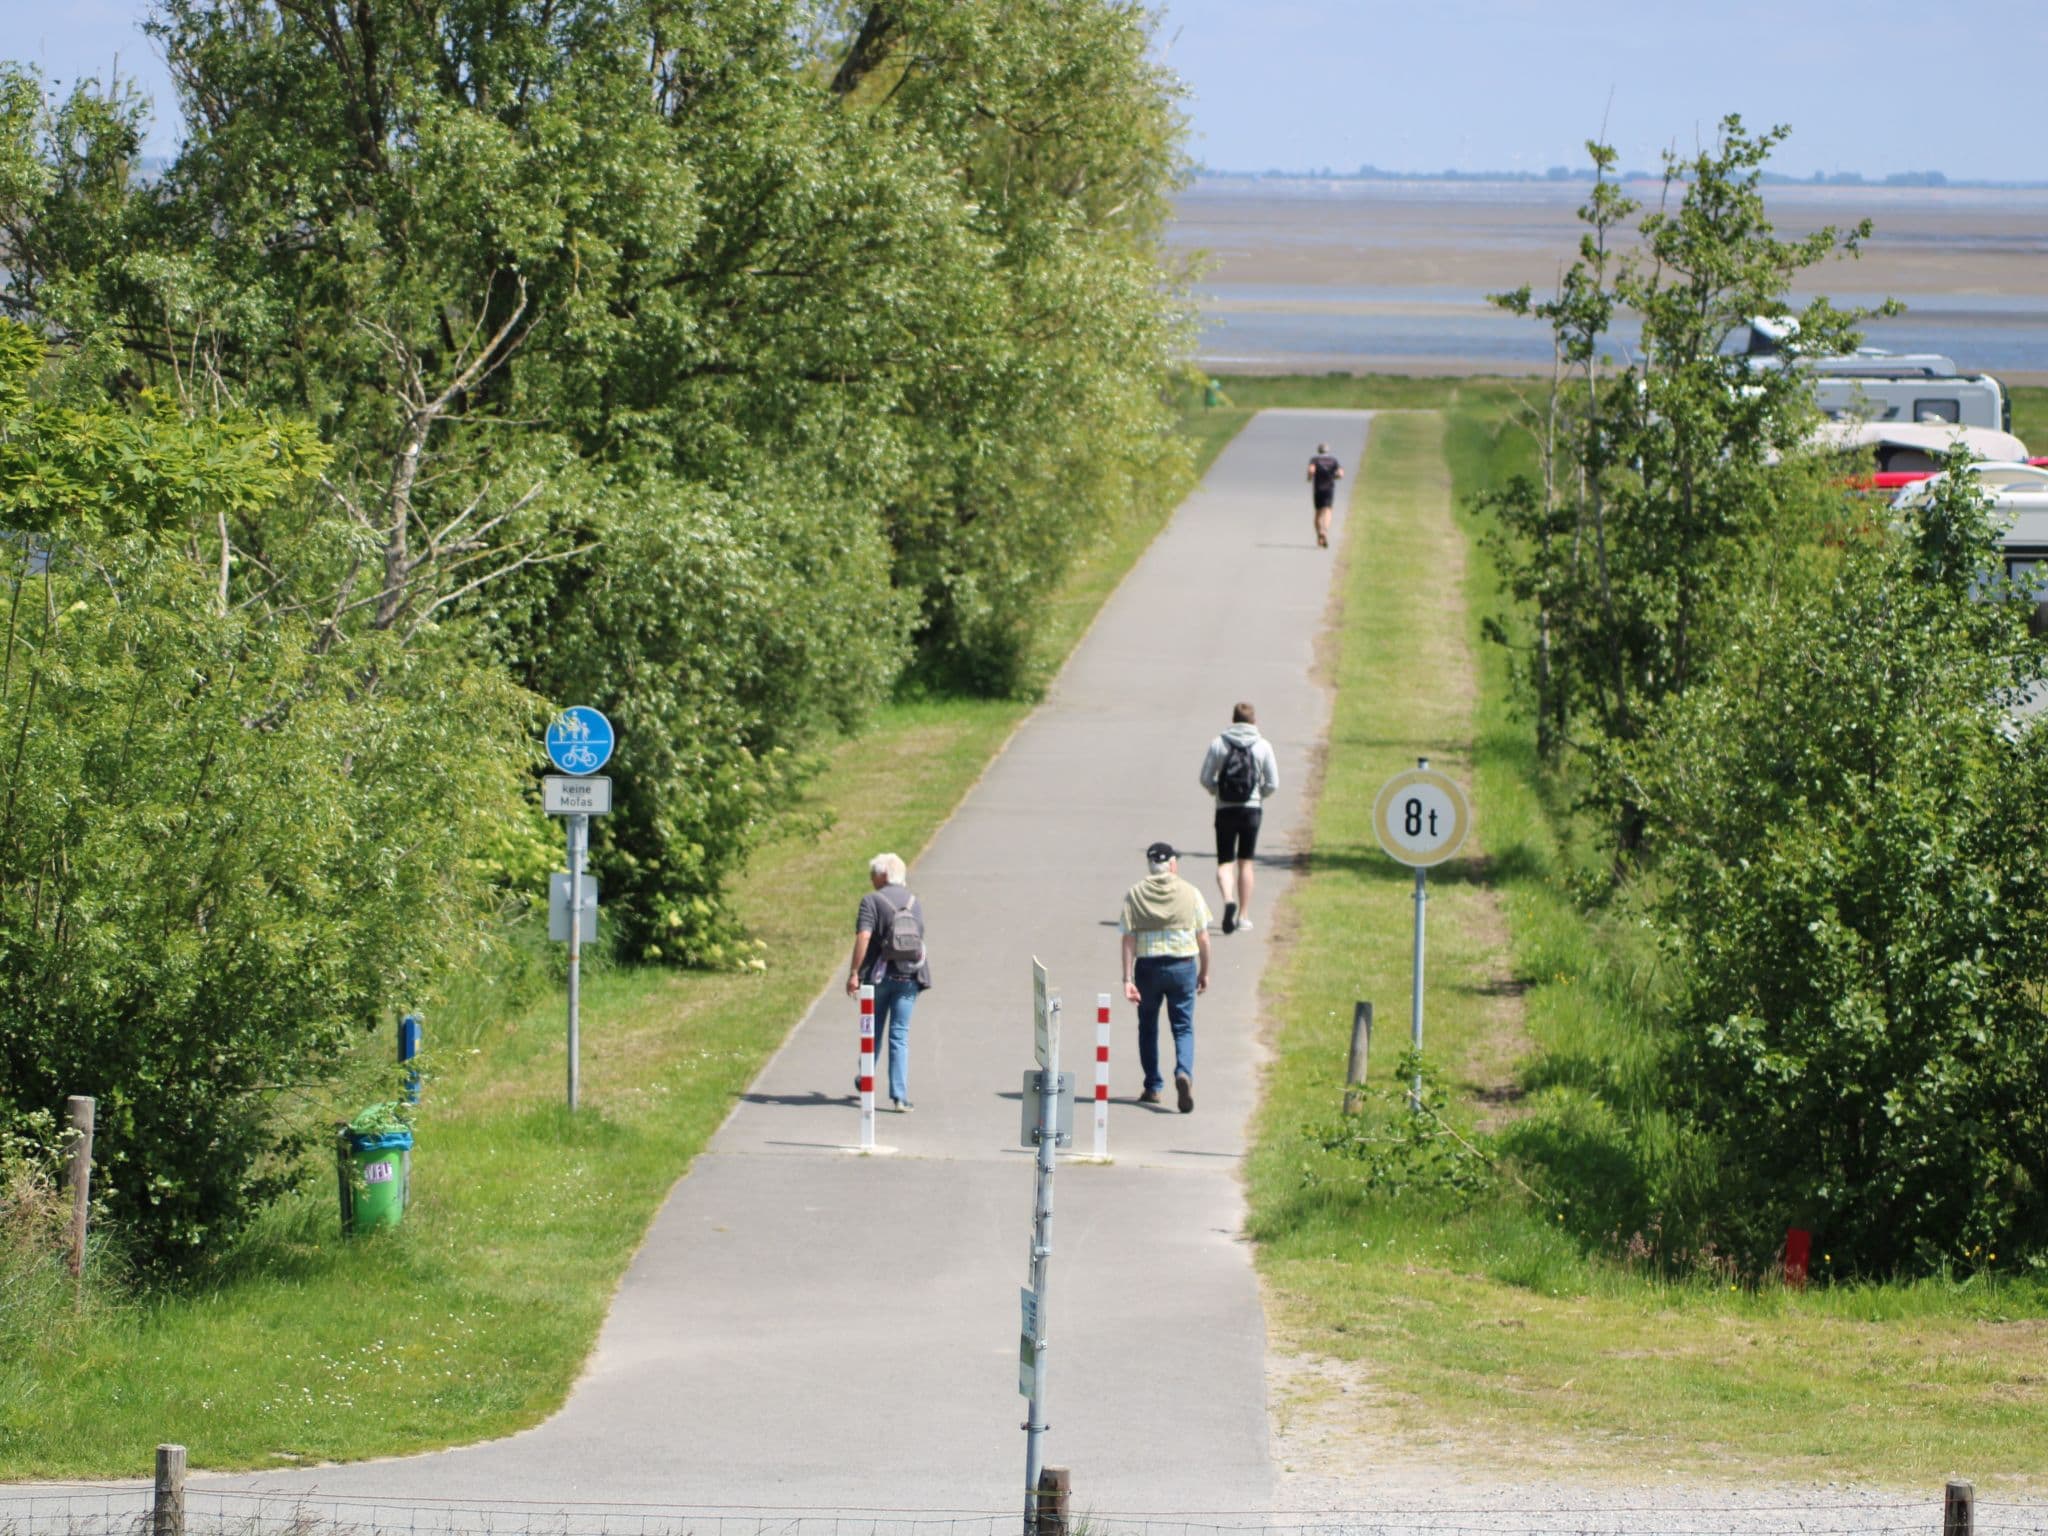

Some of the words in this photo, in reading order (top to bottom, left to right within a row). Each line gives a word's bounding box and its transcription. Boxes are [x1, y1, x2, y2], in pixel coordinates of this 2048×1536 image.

[562, 783, 592, 794] keine
[1405, 798, 1422, 837] 8
[1428, 808, 1438, 837] t
